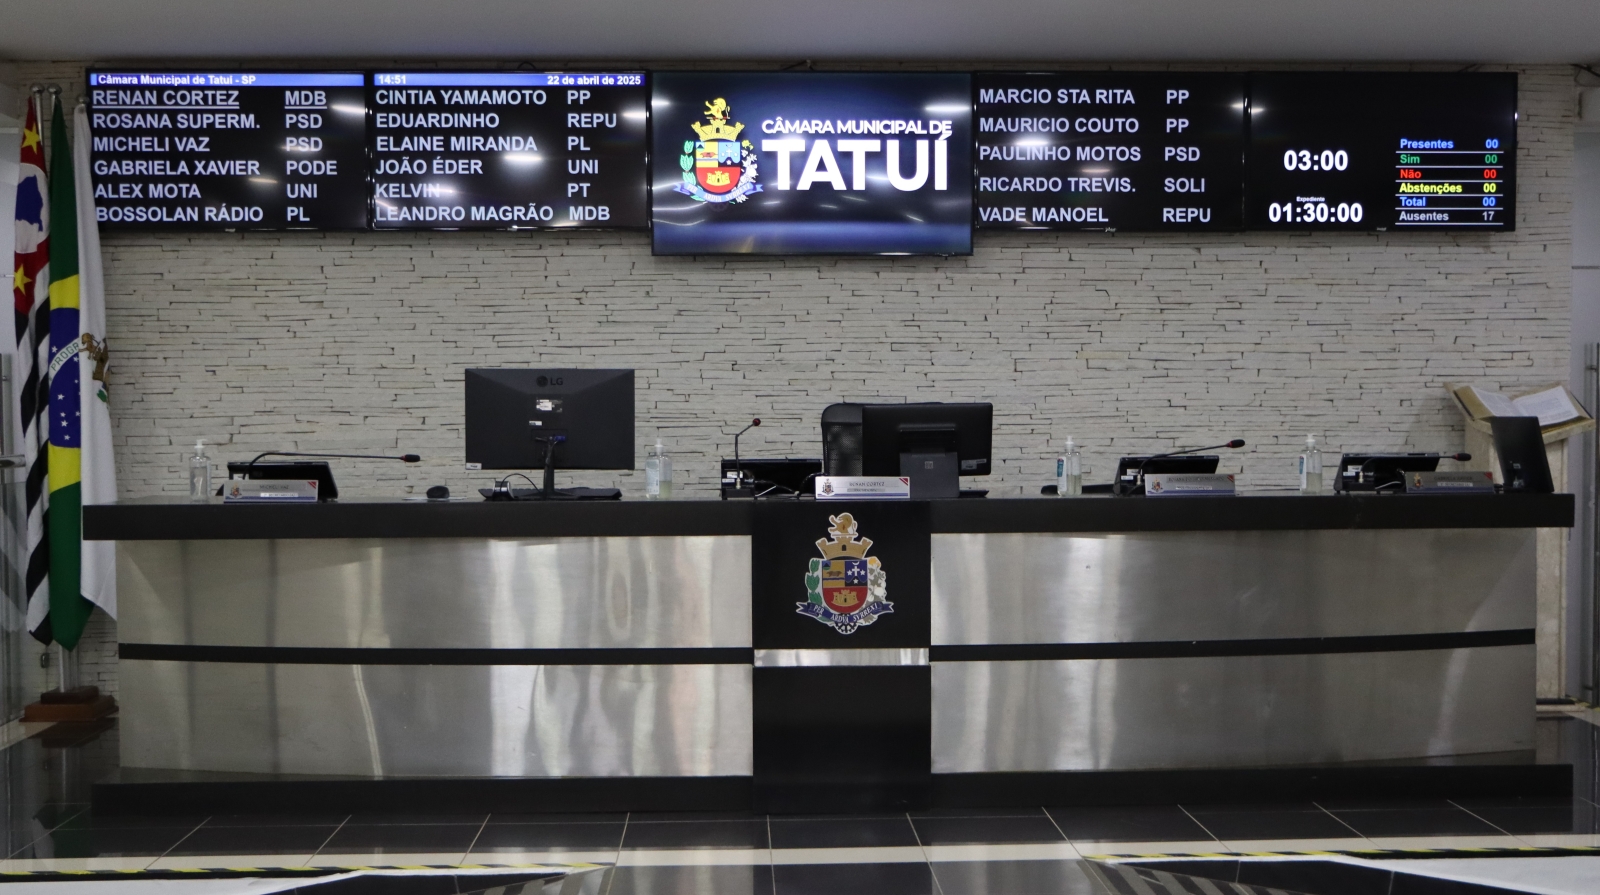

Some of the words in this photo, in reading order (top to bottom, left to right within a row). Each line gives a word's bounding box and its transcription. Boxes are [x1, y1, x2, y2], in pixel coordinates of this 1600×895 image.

[98, 75, 138, 85] Câmara
[140, 75, 190, 86] Municipal
[192, 75, 206, 85] de
[241, 75, 256, 85] SP
[378, 75, 407, 85] 14:51
[547, 75, 560, 85] 22
[561, 75, 575, 85] de
[577, 75, 600, 85] abril
[601, 75, 615, 85] de
[616, 75, 641, 85] 2025
[93, 90, 157, 105] RENAN
[163, 90, 240, 105] CORTEZ
[285, 90, 327, 105] MDB
[376, 90, 437, 105] CINTIA
[440, 90, 547, 105] YAMAMOTO
[567, 90, 591, 105] PP
[979, 89, 1052, 104] MARCIO
[1056, 89, 1092, 104] STA
[1096, 90, 1136, 104] RITA
[1166, 90, 1190, 104] PP
[94, 114, 172, 129] ROSANA
[177, 114, 260, 129] SUPERM.
[285, 114, 322, 129] PSD
[376, 113, 500, 128] EDUARDINHO
[568, 113, 617, 128] REPU
[762, 117, 835, 134] CÂMARA
[837, 120, 928, 134] MUNICIPAL
[929, 120, 952, 134] DE
[979, 118, 1070, 133] MAURICIO
[1075, 118, 1140, 133] COUTO
[1166, 119, 1190, 133] PP
[94, 137, 169, 151] MICHELI
[175, 137, 210, 151] VAZ
[286, 137, 323, 152] PSD
[377, 136, 445, 151] ELAINE
[450, 136, 538, 151] MIRANDA
[568, 136, 590, 150] PL
[1400, 138, 1454, 150] Presentes
[1485, 139, 1499, 149] 00
[979, 146, 1071, 161] PAULINHO
[1076, 146, 1142, 161] MOTOS
[1164, 147, 1201, 161] PSD
[1283, 150, 1349, 171] 03:00
[1400, 154, 1420, 164] Sim
[1484, 154, 1498, 164] 00
[95, 161, 190, 175] GABRIELA
[194, 161, 261, 175] XAVIER
[287, 161, 338, 175] PODE
[376, 157, 428, 174] JOÃO
[432, 156, 483, 174] ÉDER
[568, 159, 599, 174] UNI
[762, 134, 952, 192] TATUÍ
[1400, 169, 1422, 179] Não
[1483, 169, 1497, 178] 00
[95, 184, 144, 198] ALEX
[149, 184, 202, 198] MOTA
[287, 184, 318, 198] UNI
[375, 184, 441, 198] KELVIN
[567, 183, 591, 198] PT
[979, 177, 1062, 192] RICARDO
[1067, 177, 1136, 192] TREVIS.
[1163, 178, 1206, 193] SOLI
[1399, 183, 1463, 194] Abstenções
[1483, 183, 1497, 193] 00
[1400, 196, 1426, 207] Total
[1482, 196, 1496, 206] 00
[96, 207, 199, 222] BOSSOLAN
[204, 203, 264, 222] RÁDIO
[287, 207, 310, 221] PL
[376, 206, 465, 221] LEANDRO
[471, 203, 554, 222] MAGRÃO
[569, 206, 611, 221] MDB
[979, 207, 1027, 222] VADE
[1032, 207, 1109, 222] MANOEL
[1162, 208, 1211, 222] REPU
[1268, 203, 1364, 223] 01:30:00
[1399, 211, 1450, 221] Ausentes
[1482, 211, 1495, 221] 17
[550, 377, 564, 386] LG
[813, 604, 825, 615] PER
